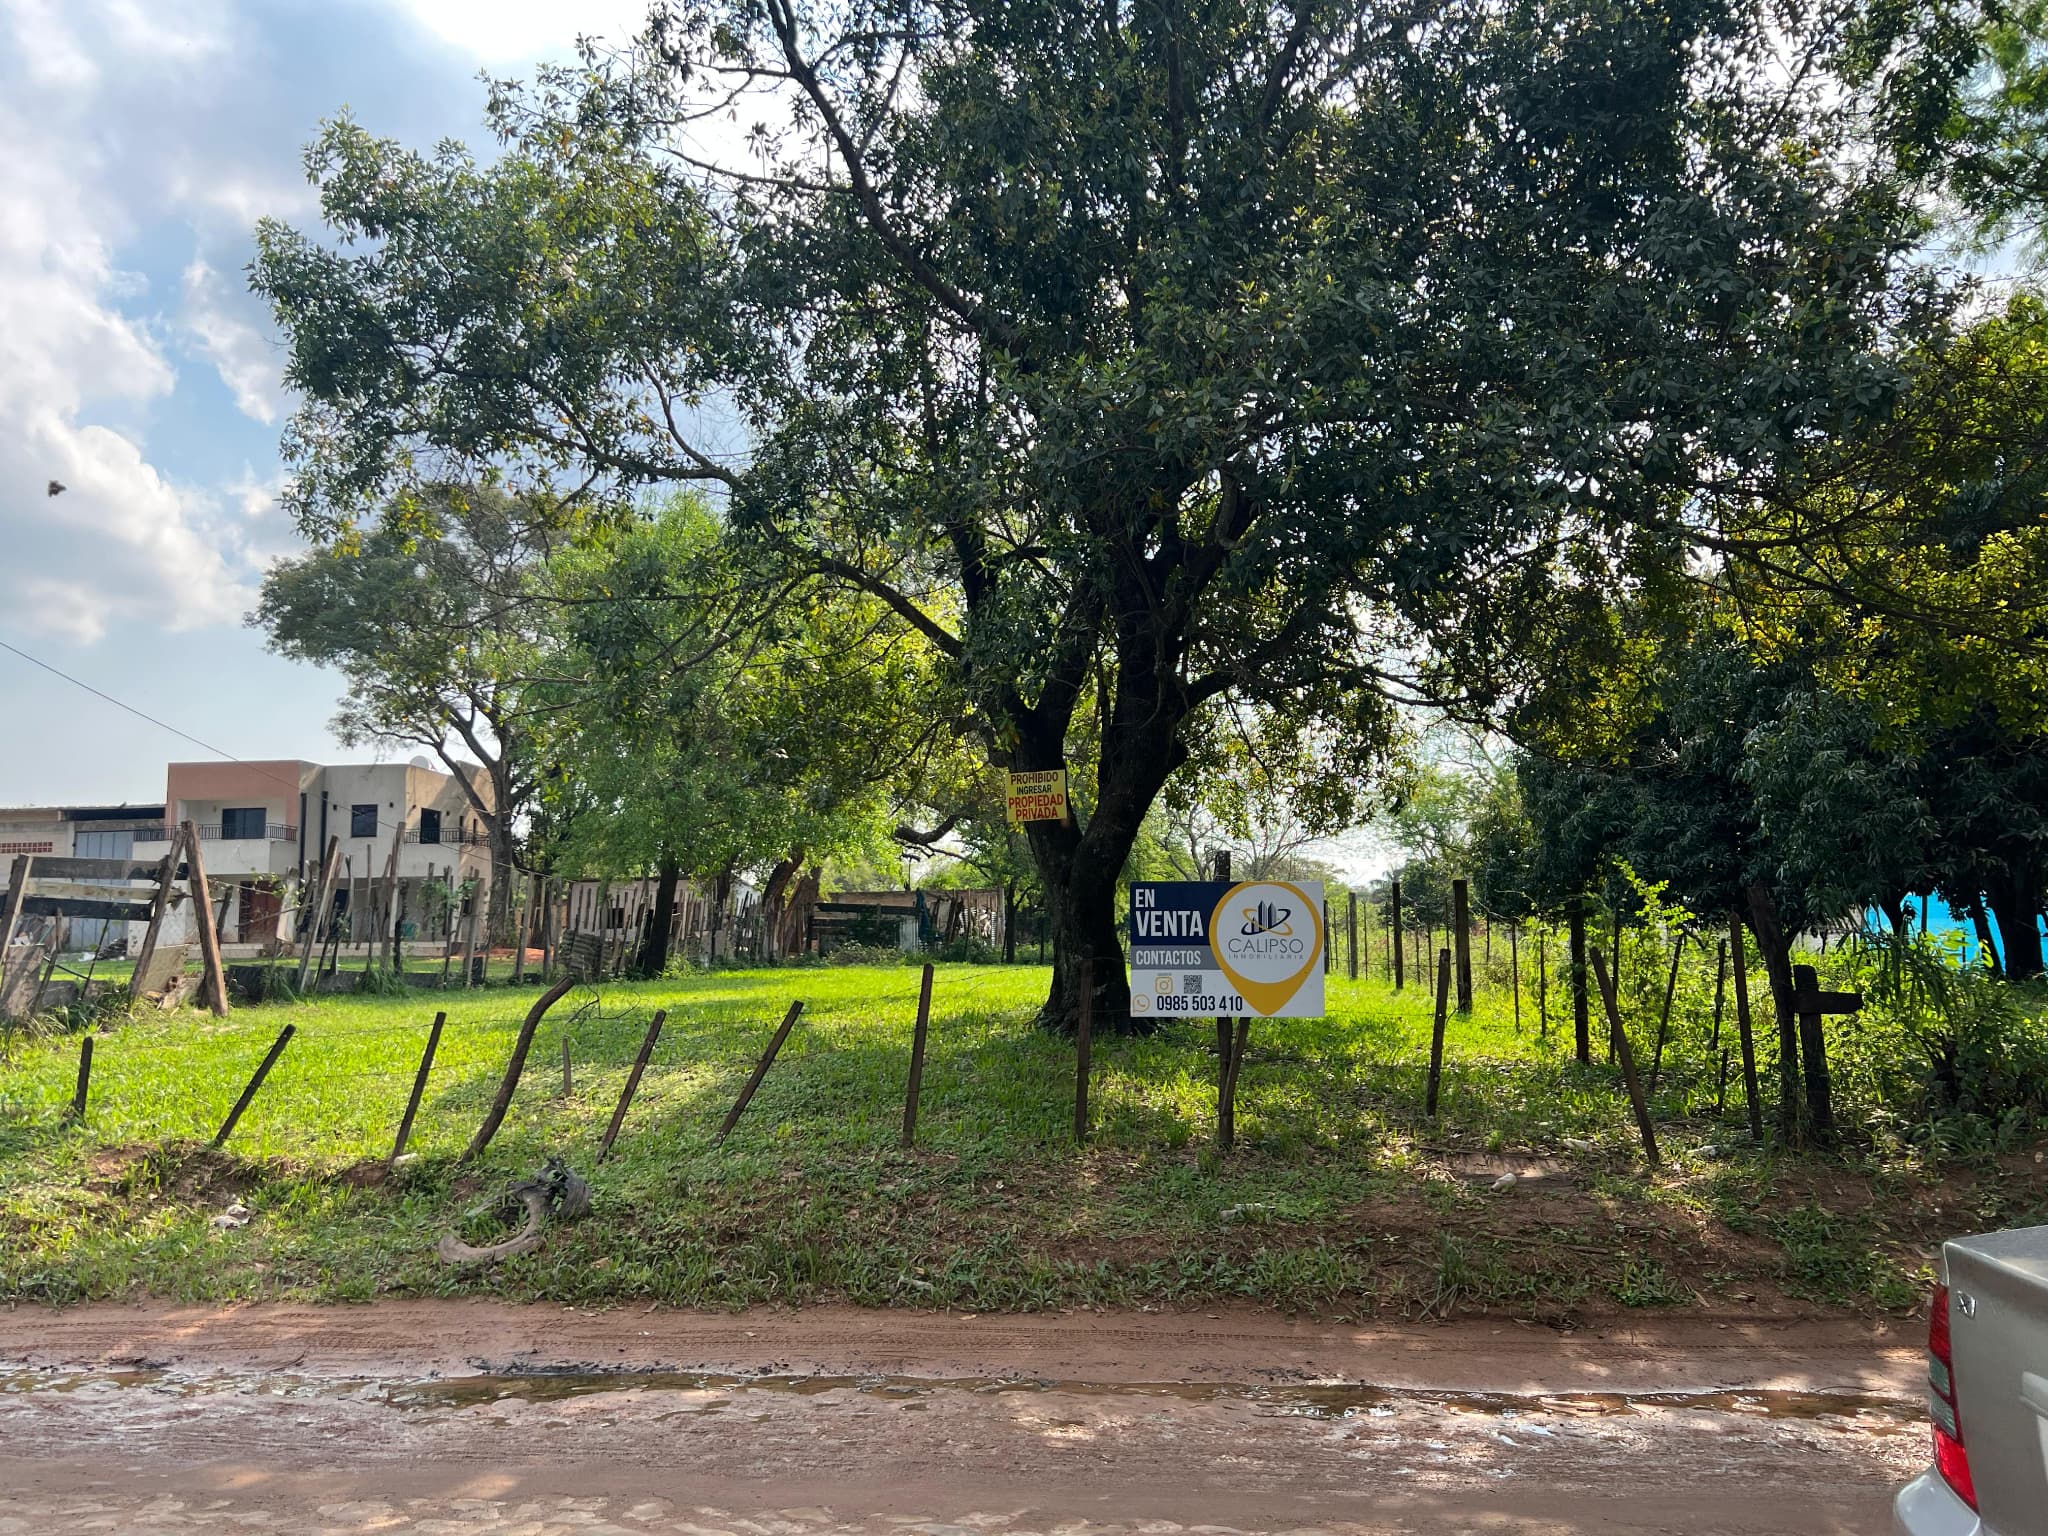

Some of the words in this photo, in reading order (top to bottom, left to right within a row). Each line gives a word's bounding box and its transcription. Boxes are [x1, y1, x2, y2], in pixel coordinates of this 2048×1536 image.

[1010, 771, 1059, 785] PROHIBIDO
[1016, 784, 1052, 795] INGRESAR
[1008, 793, 1064, 809] PROPIEDAD
[1015, 806, 1058, 820] PRIVADA
[1135, 888, 1155, 908] EN
[1136, 910, 1204, 937] VENTA
[1228, 937, 1304, 954] CALIPSO
[1135, 950, 1201, 966] CONTACTOS
[1156, 995, 1188, 1011] 0985
[1192, 995, 1216, 1011] 503
[1219, 995, 1243, 1011] 410
